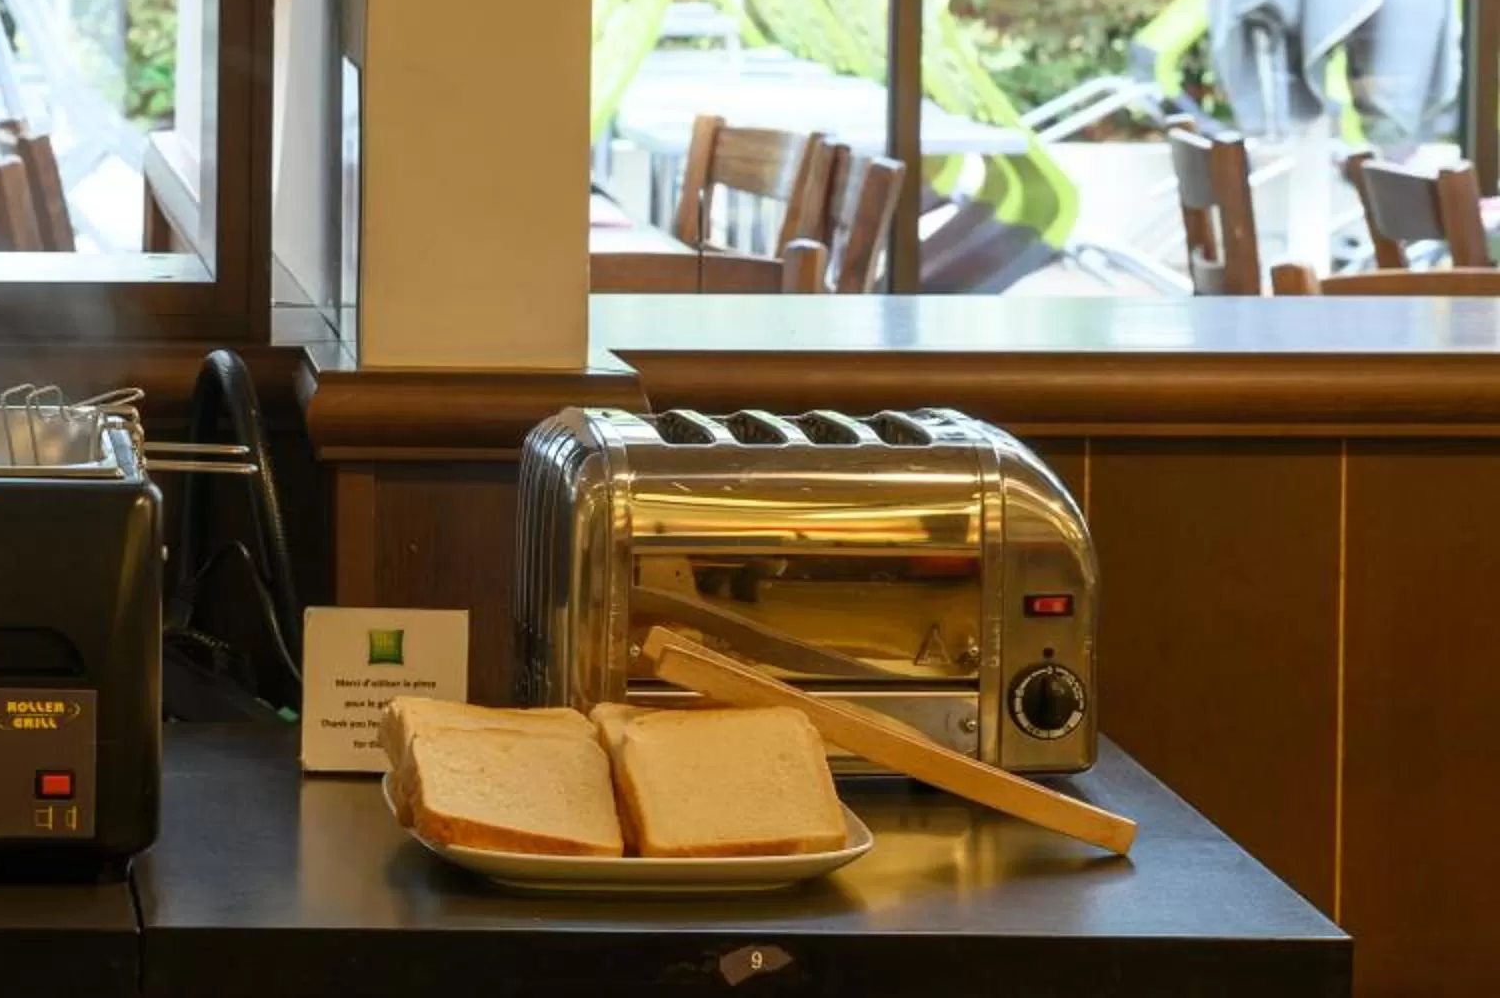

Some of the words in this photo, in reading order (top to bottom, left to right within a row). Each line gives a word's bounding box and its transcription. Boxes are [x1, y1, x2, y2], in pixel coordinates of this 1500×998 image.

[7, 701, 65, 714] ROLLER
[13, 717, 58, 730] GRILL
[751, 951, 763, 969] 9
